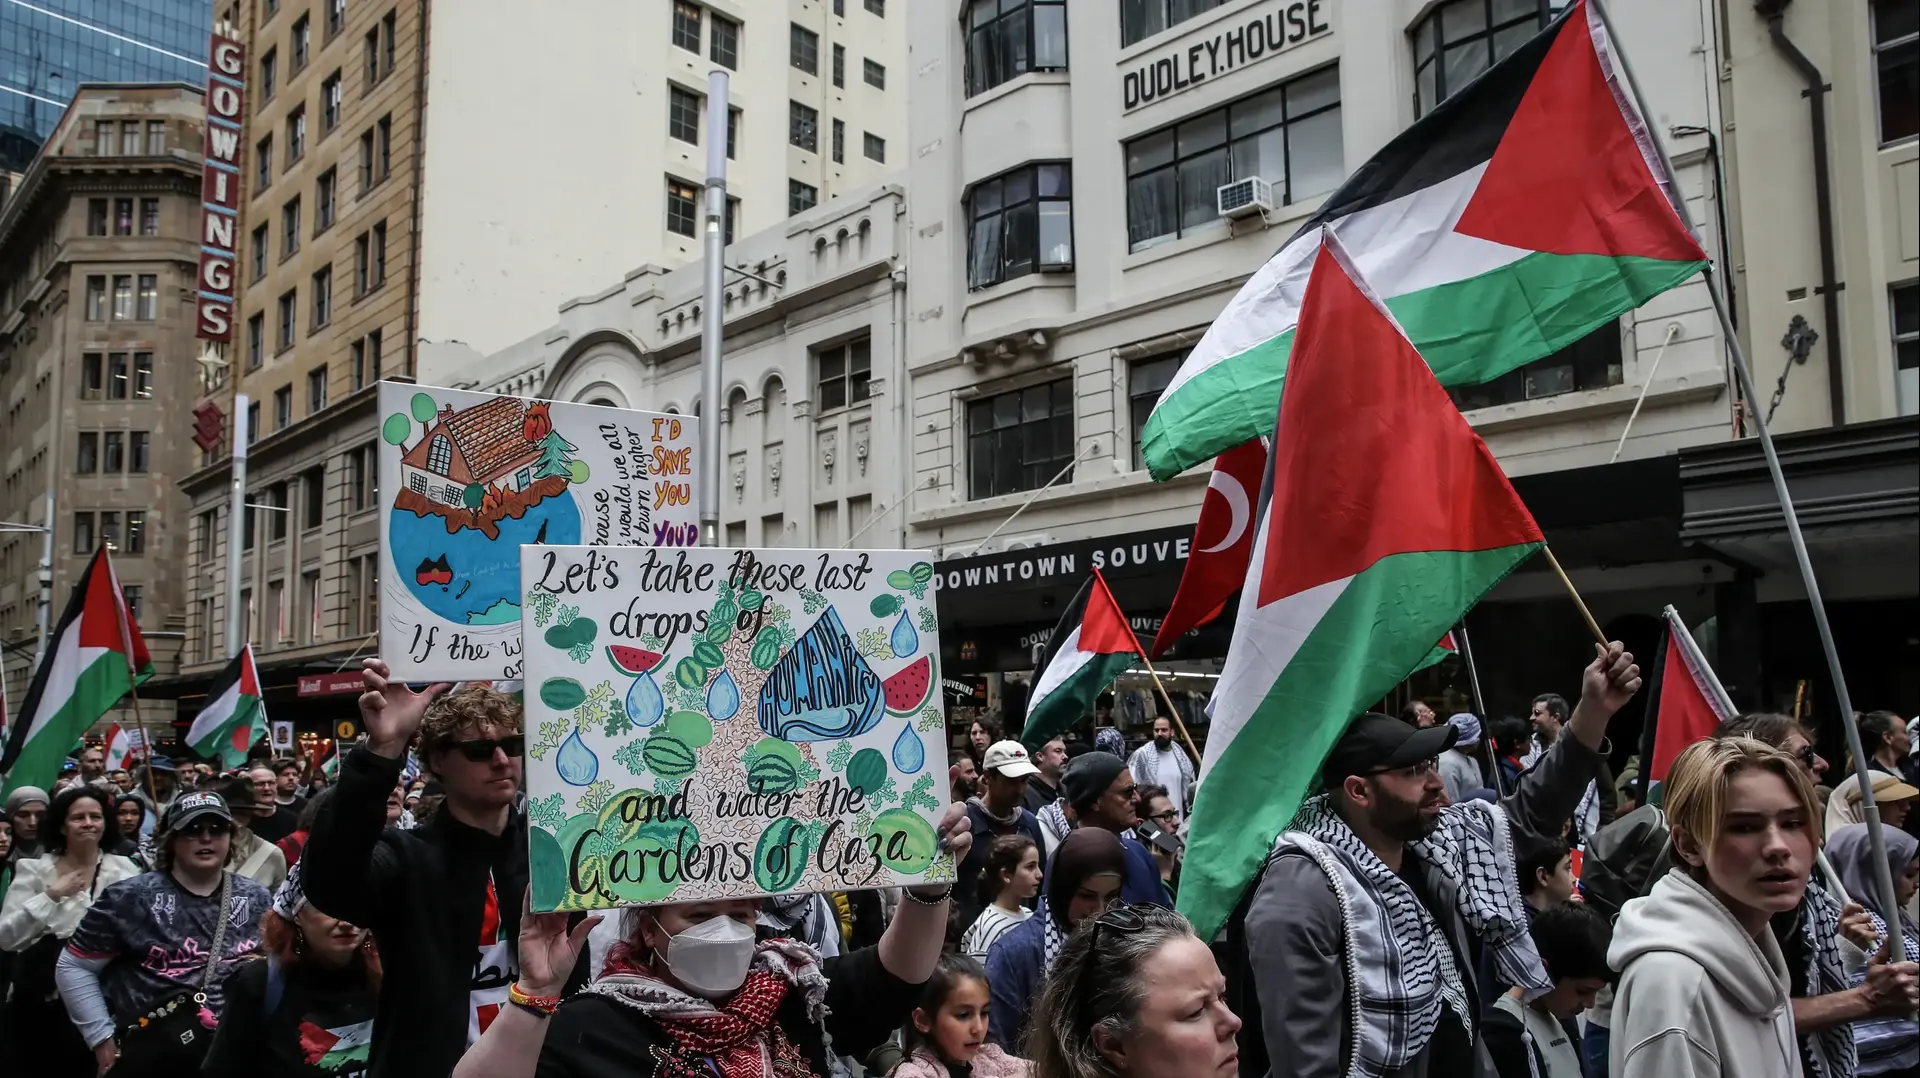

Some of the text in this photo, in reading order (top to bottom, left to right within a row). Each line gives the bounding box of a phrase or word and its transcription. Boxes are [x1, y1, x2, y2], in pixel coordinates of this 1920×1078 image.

[202, 44, 241, 335] GOWINGS
[599, 423, 622, 450] all
[651, 418, 681, 442] I'D
[614, 455, 629, 480] we
[624, 426, 654, 480] higher
[648, 445, 691, 476] SAVE
[613, 484, 632, 538] would
[653, 480, 690, 511] YOU
[652, 520, 698, 546] YOU'D
[533, 549, 872, 594] Let's take these last
[934, 538, 1189, 590] DOWNTOWN SOUVE
[409, 624, 439, 663] If
[447, 634, 489, 660] the
[609, 594, 773, 654] drops of
[942, 678, 974, 696] OUVENIRS
[620, 776, 865, 824] and water the
[569, 826, 751, 901] Gardens
[766, 824, 801, 886] of
